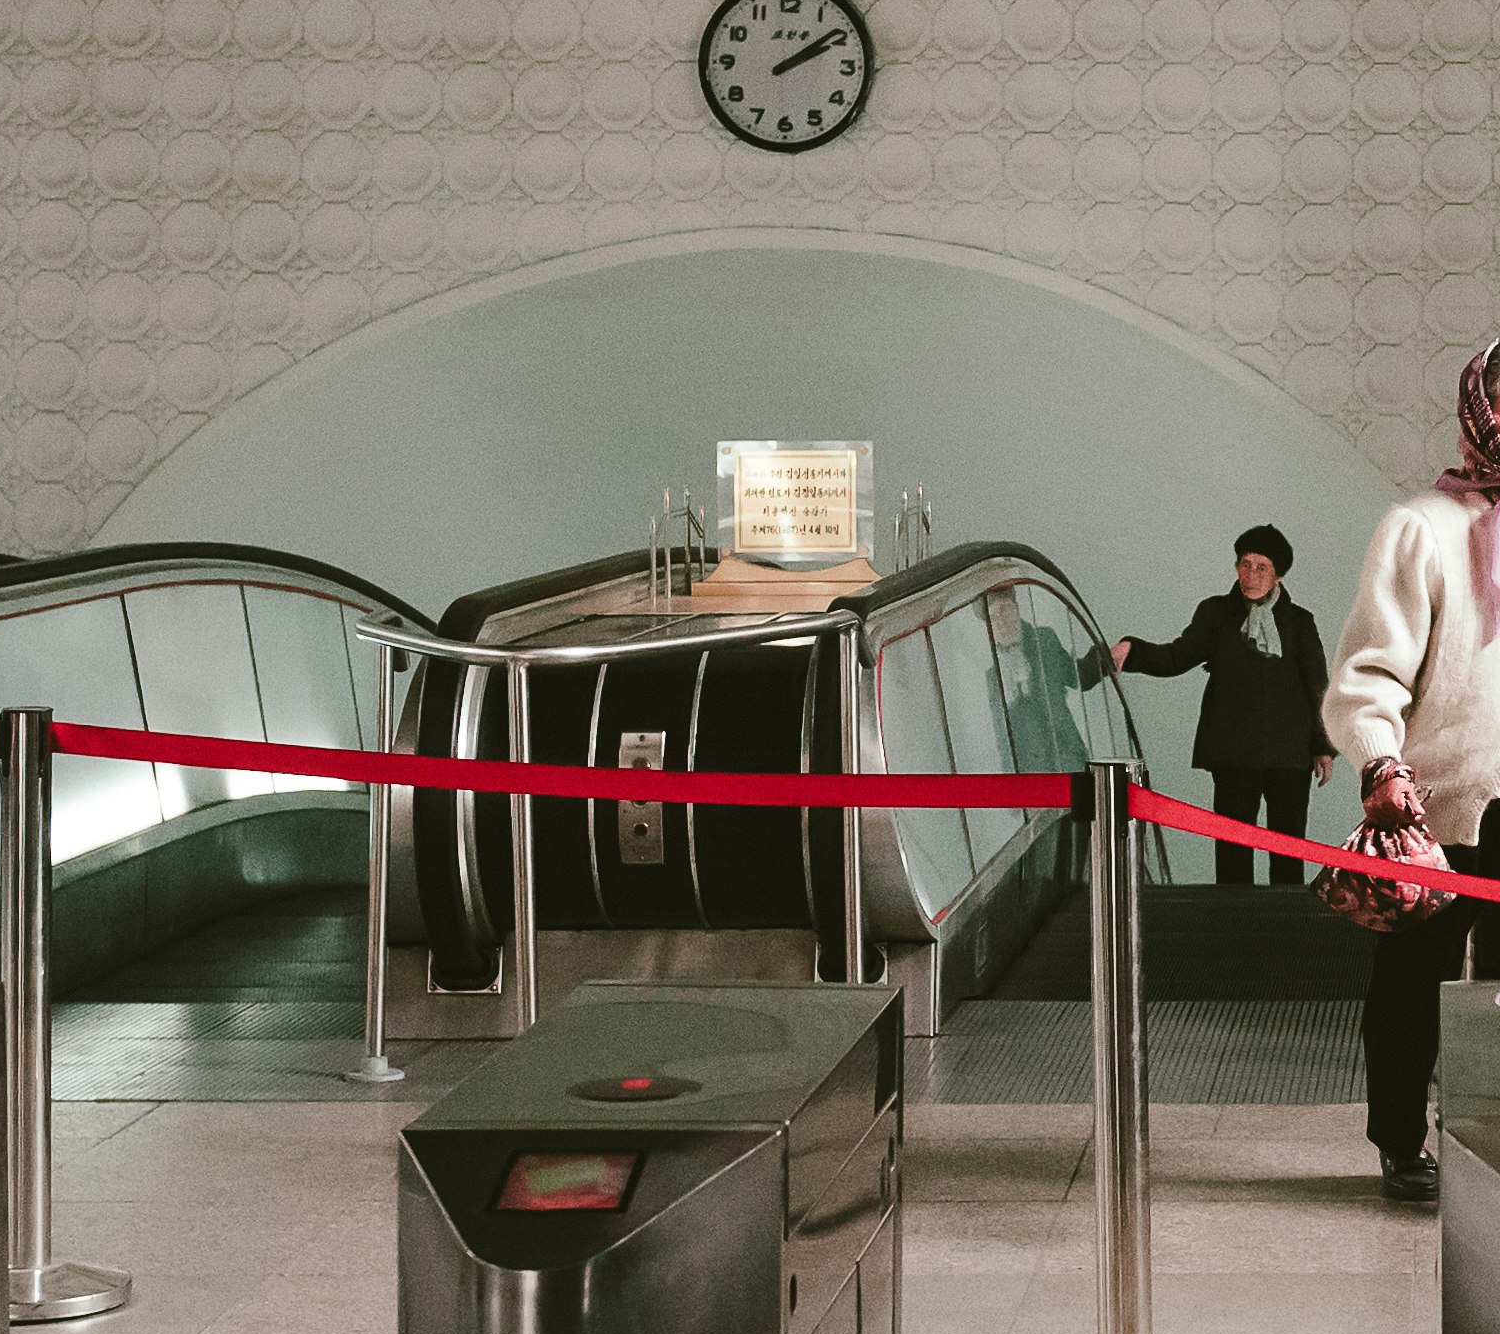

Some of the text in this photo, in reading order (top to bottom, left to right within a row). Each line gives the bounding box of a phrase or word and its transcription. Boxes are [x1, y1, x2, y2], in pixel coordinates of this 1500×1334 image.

[752, 5, 766, 21] 11
[817, 6, 823, 23] 1
[729, 26, 747, 42] 10
[831, 29, 847, 46] 2
[719, 54, 735, 70] 9
[839, 59, 856, 76] 3
[728, 85, 744, 102] 8
[828, 90, 845, 106] 4
[750, 108, 765, 124] 7
[777, 116, 793, 133] 6
[807, 109, 823, 126] 5
